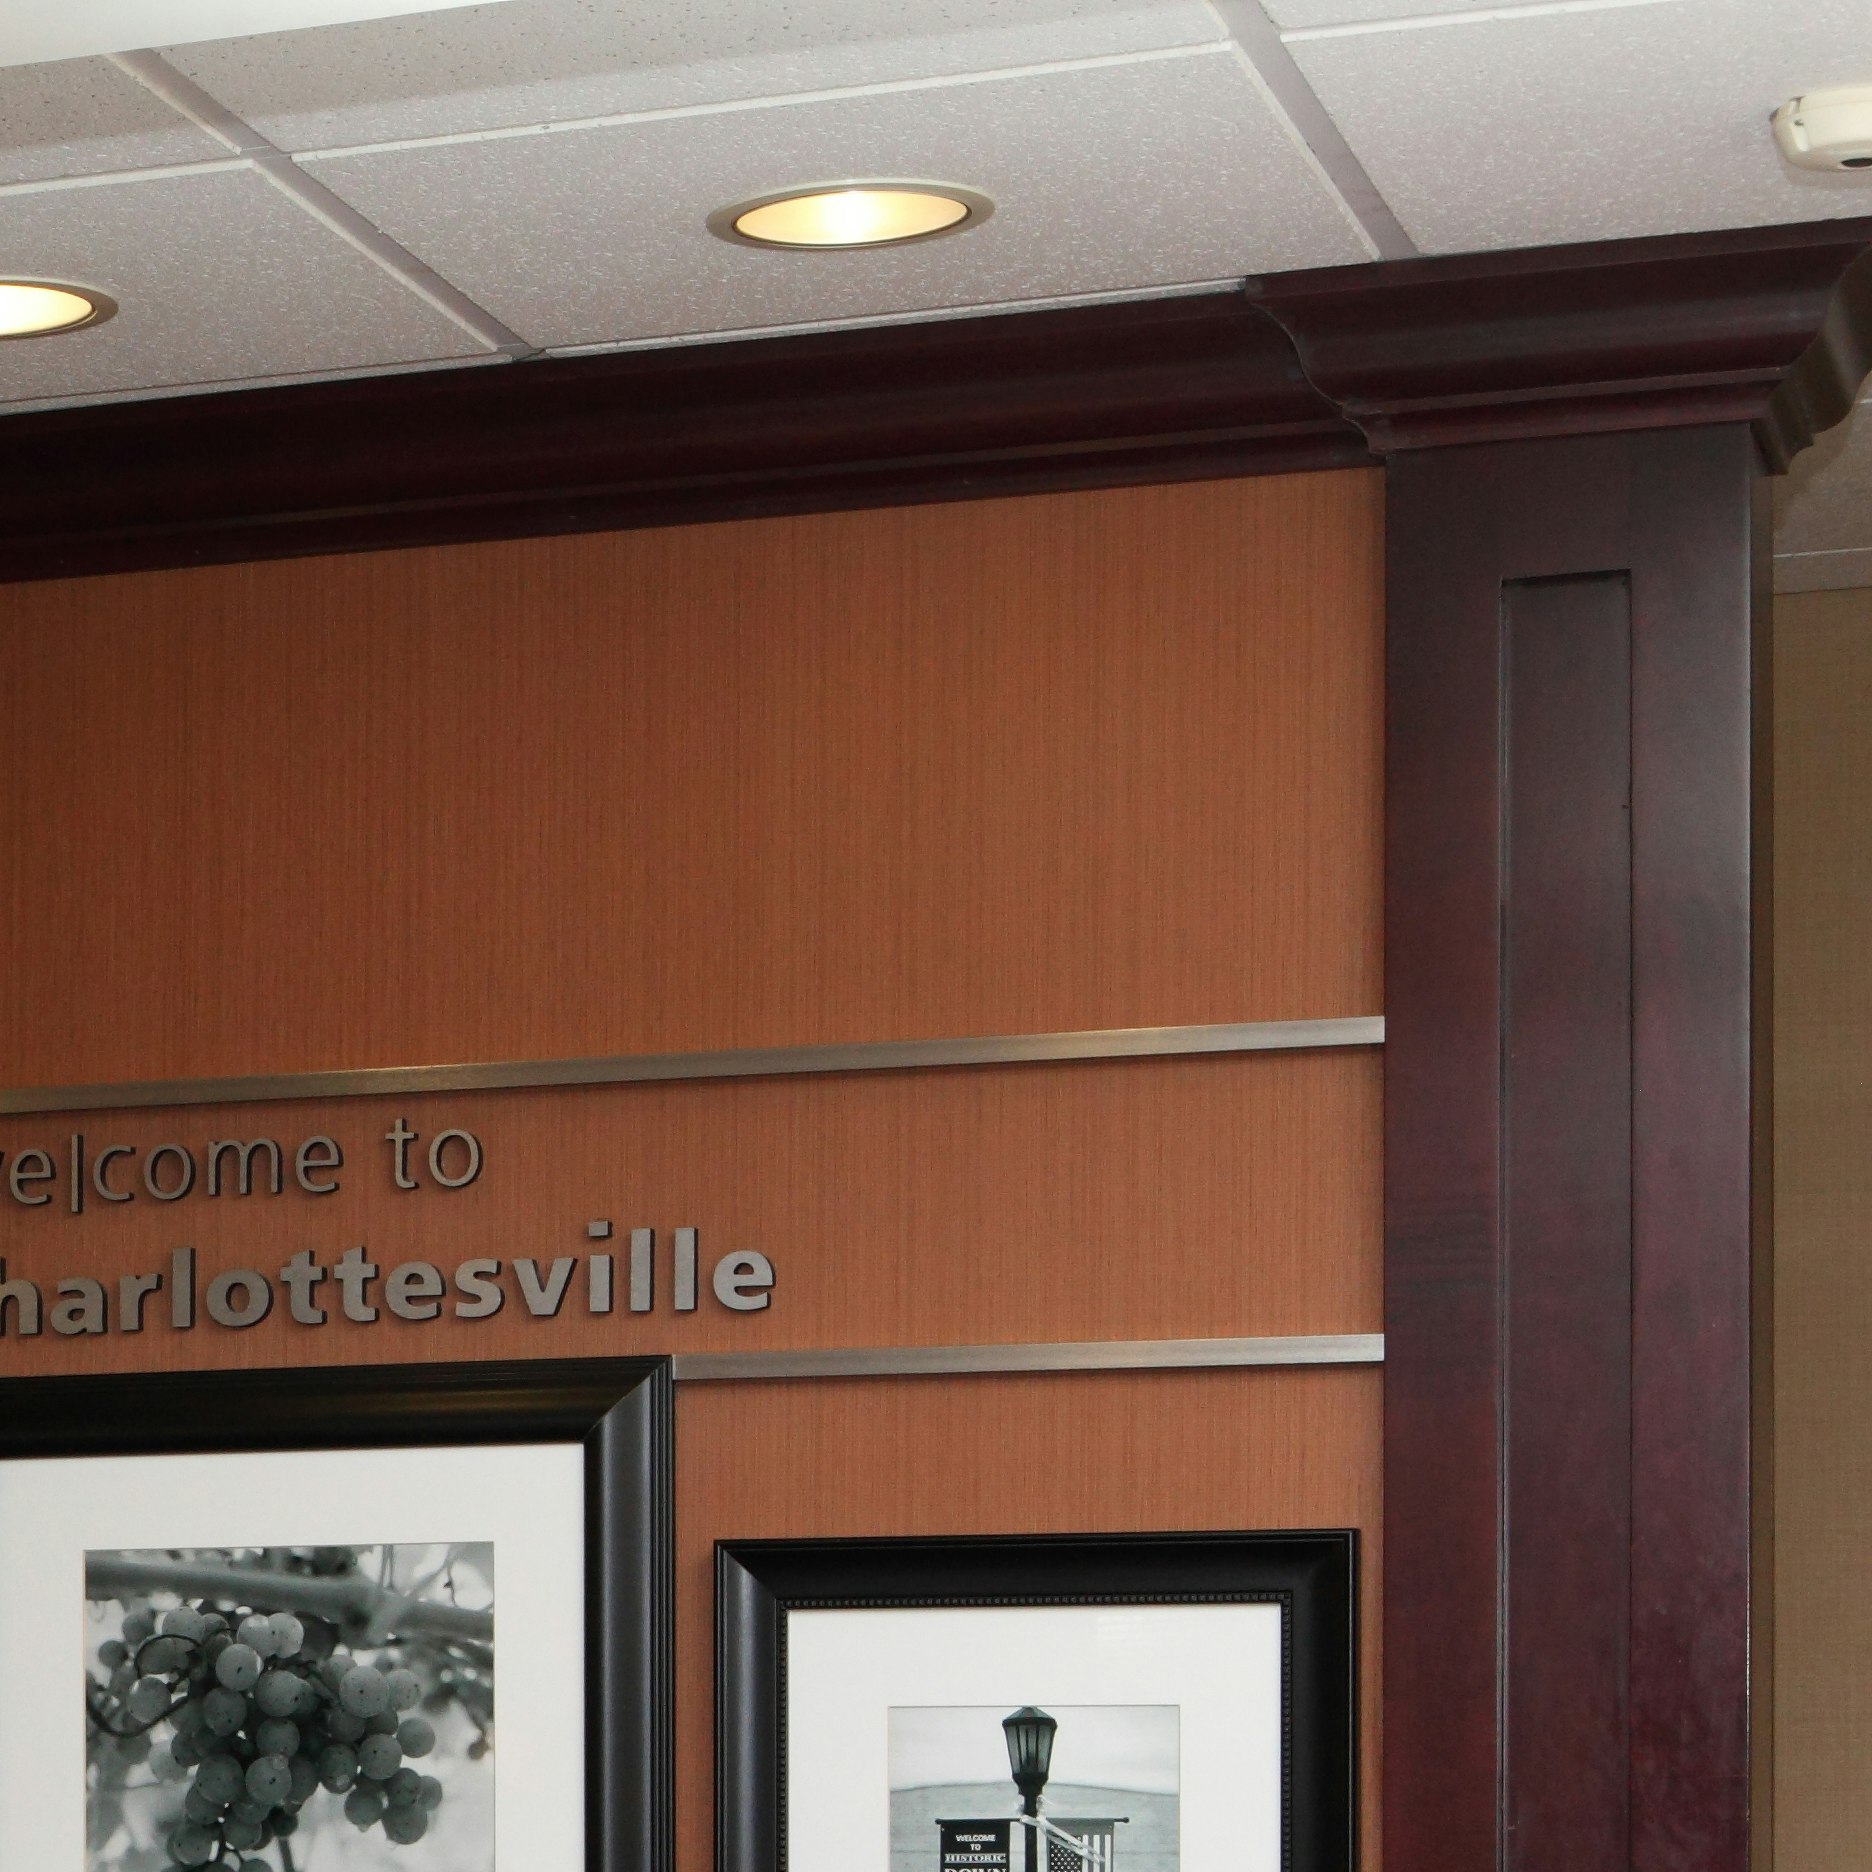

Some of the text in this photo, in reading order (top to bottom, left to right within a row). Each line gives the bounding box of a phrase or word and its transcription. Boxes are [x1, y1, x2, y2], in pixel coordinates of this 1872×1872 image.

[387, 1118, 483, 1191] to
[956, 1834, 996, 1842] WELCOME
[945, 1854, 1006, 1863] HISTORIC
